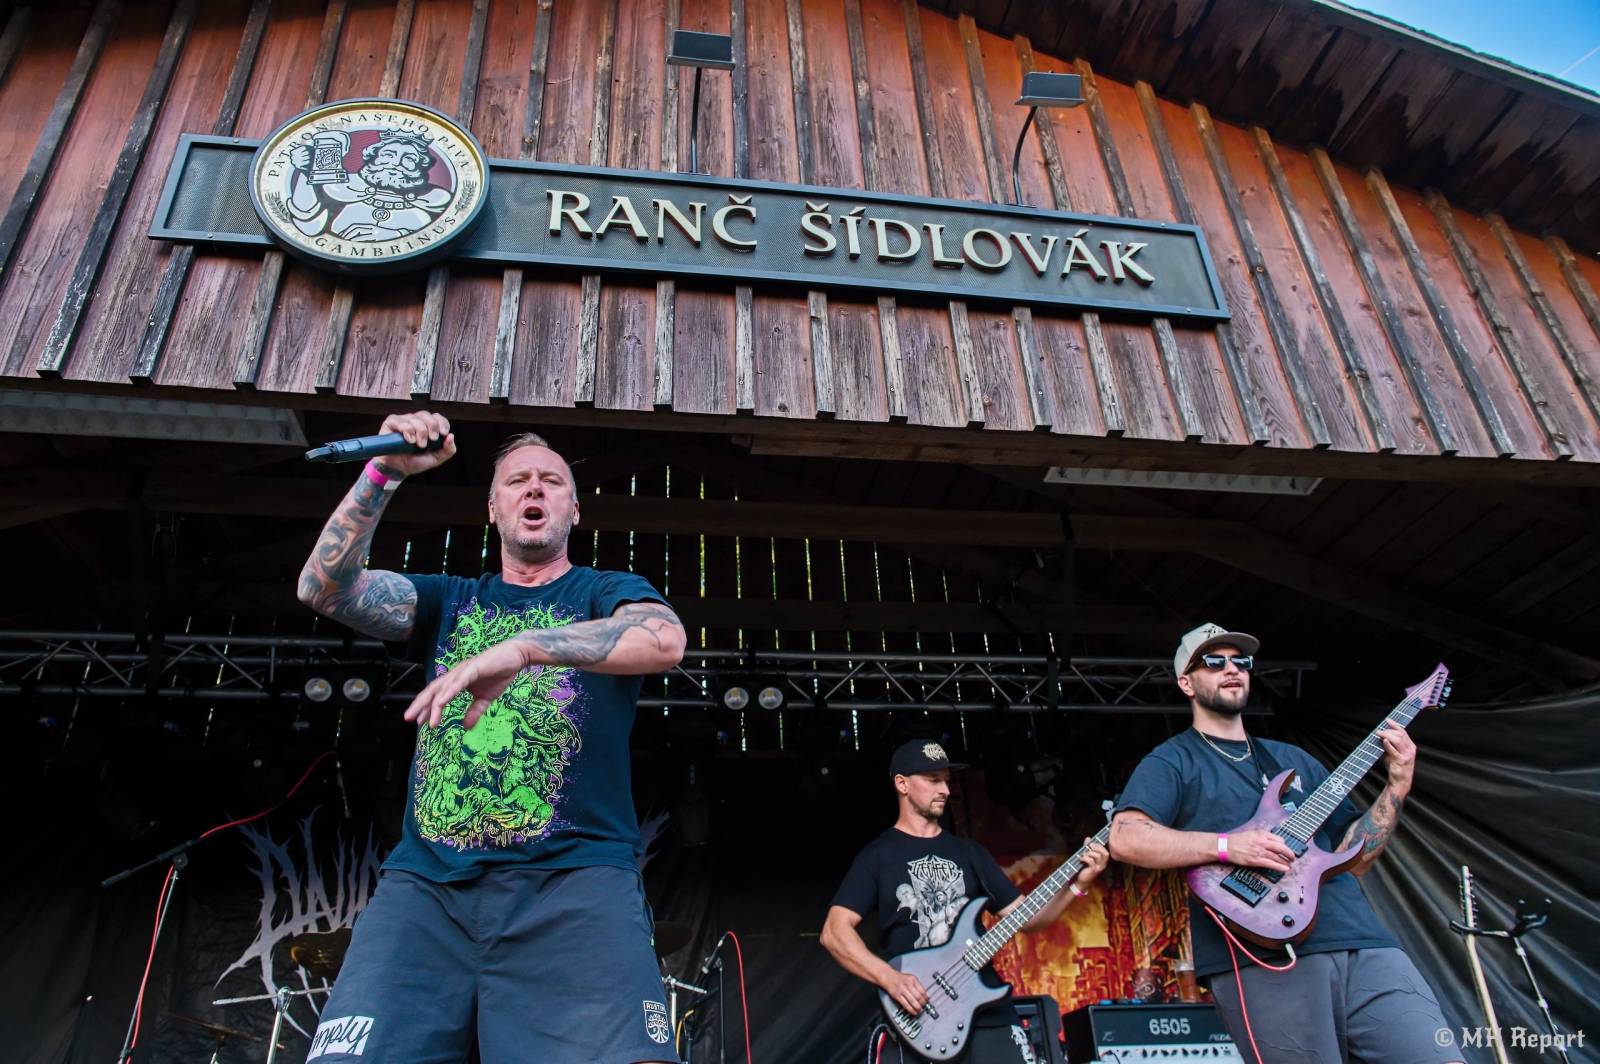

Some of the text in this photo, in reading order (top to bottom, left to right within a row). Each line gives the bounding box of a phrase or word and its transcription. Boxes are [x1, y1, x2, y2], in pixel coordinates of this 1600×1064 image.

[267, 123, 329, 177] PATRON
[314, 215, 456, 257] GAMBRINUS
[546, 189, 1156, 288] RANČ ŠÍDLOVÁK
[1149, 1018, 1191, 1035] 6505
